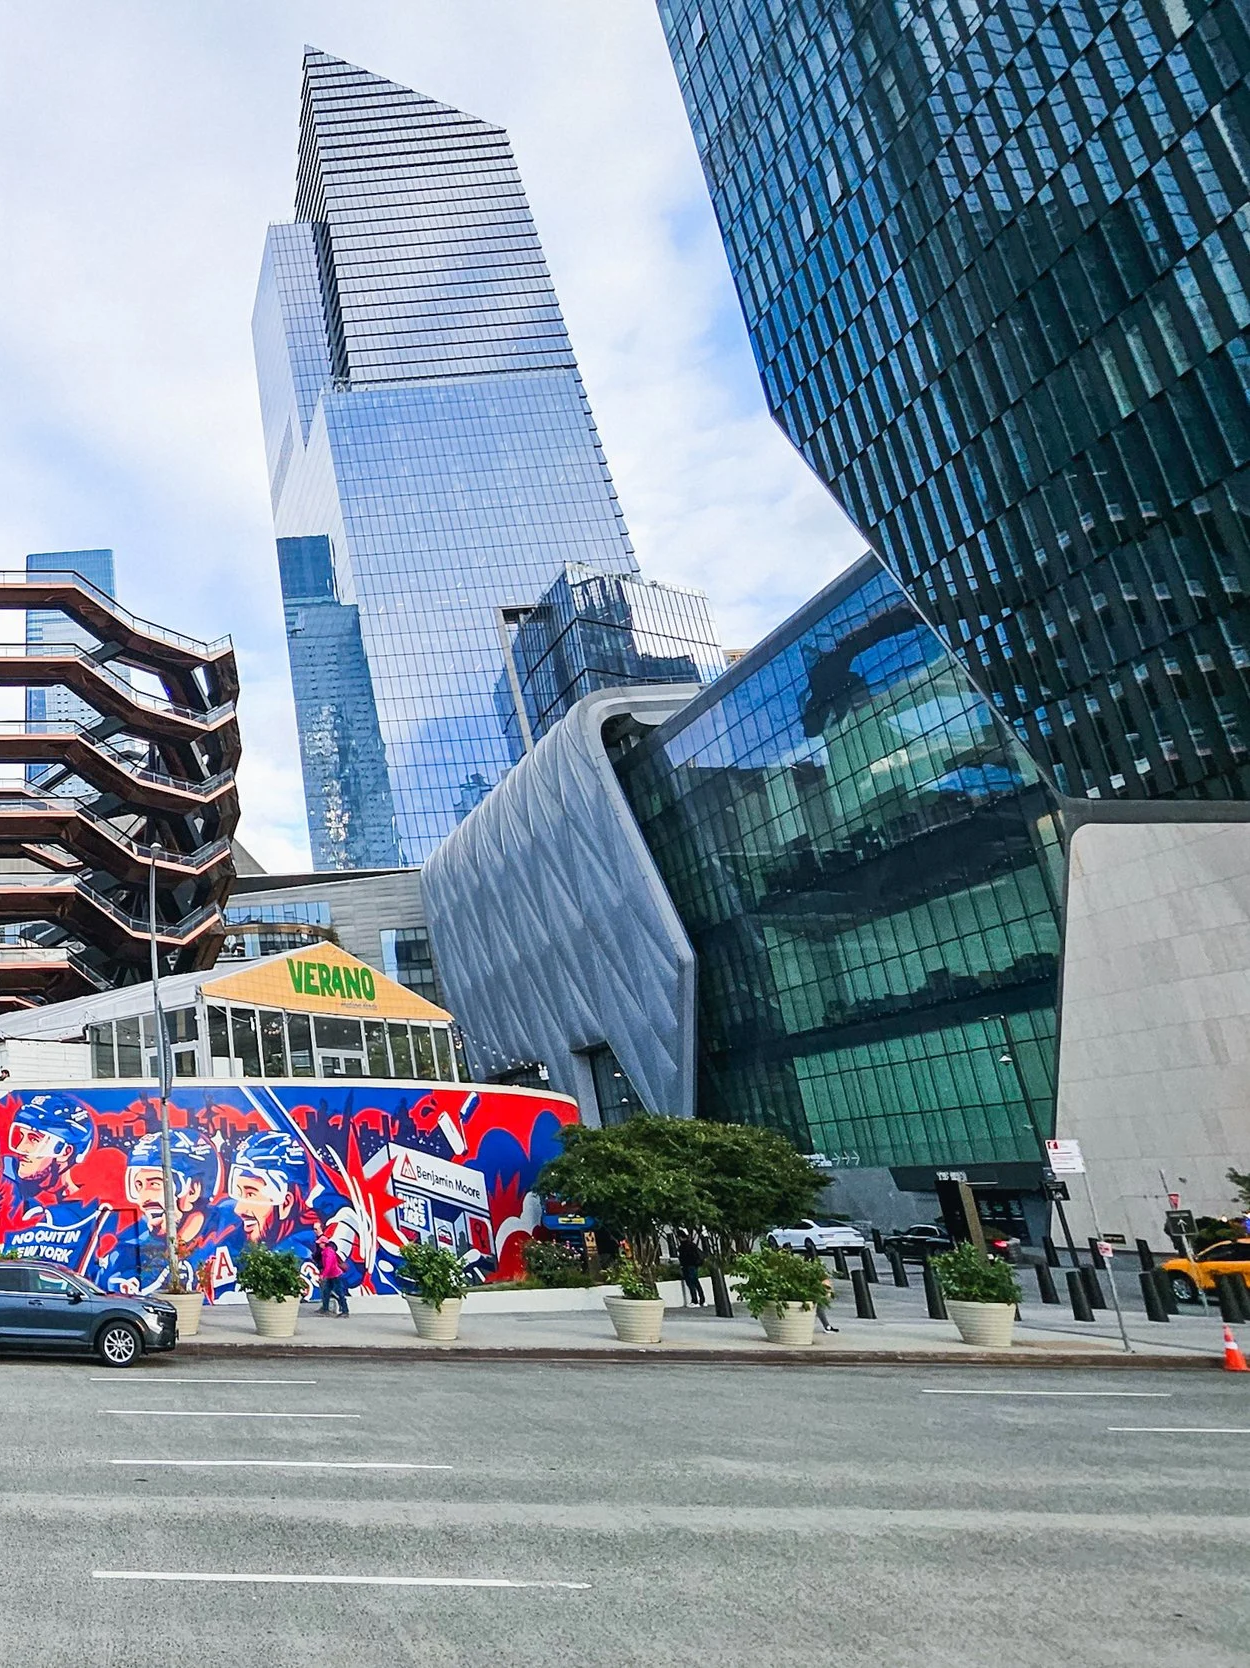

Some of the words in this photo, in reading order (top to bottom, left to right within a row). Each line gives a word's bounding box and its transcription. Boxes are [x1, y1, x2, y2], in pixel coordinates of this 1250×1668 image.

[286, 957, 376, 1001] VERANO
[416, 1166, 454, 1189] Benjamin
[455, 1180, 481, 1200] Moore
[397, 1192, 426, 1213] SINCE
[11, 1231, 35, 1245] NO
[35, 1230, 65, 1244] QUIT
[63, 1230, 81, 1244] IN
[39, 1245, 73, 1263] YORK
[215, 1251, 234, 1280] A
